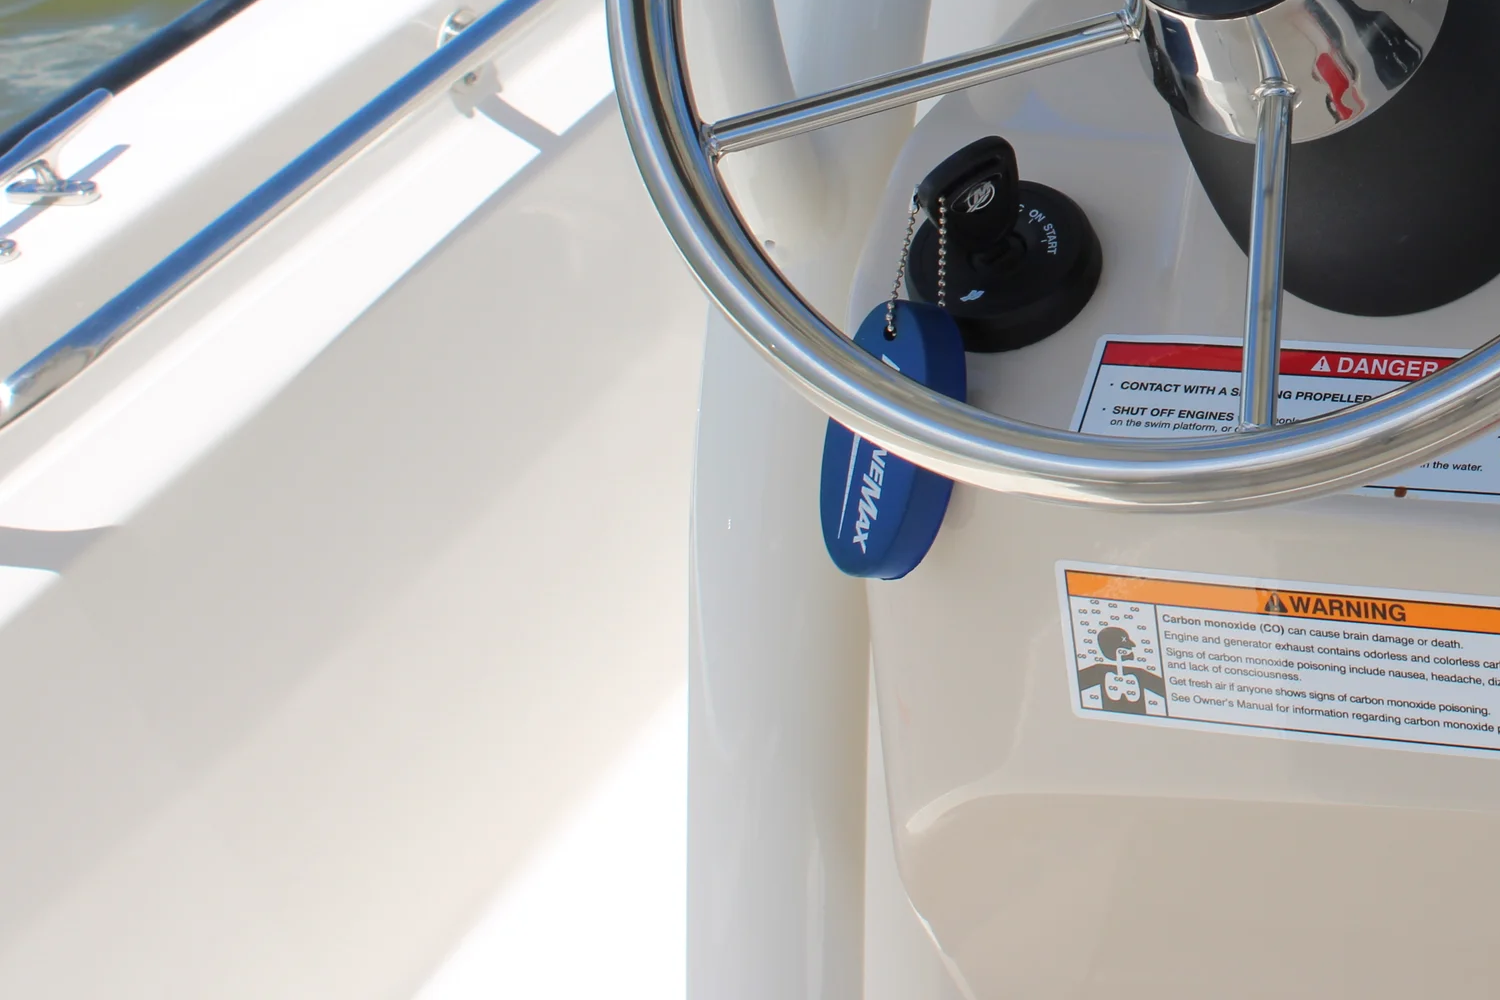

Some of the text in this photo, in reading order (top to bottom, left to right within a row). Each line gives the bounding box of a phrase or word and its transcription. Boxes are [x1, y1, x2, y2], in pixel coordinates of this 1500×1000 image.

[1028, 208, 1058, 255] ON START
[1337, 356, 1439, 378] DANGER
[1120, 380, 1181, 394] CONTACT
[1184, 384, 1216, 395] WITH
[1218, 387, 1228, 396] A
[1110, 418, 1232, 433] on the swim platform, or
[1112, 405, 1234, 422] SHUT OFF ENGINES
[1432, 460, 1449, 470] the
[1452, 462, 1483, 472] water.
[1287, 596, 1407, 622] WARNING
[1162, 614, 1464, 649] Carbon monoxide (CO) can cause brain damage or death.
[1164, 630, 1199, 643] Engine
[1202, 634, 1221, 644] and
[1223, 638, 1272, 649] generator
[1275, 641, 1314, 653] exhaust
[1317, 645, 1360, 657] contains
[1364, 648, 1408, 661] odorless
[1410, 653, 1430, 663] and
[1433, 655, 1480, 667] colorless
[1166, 647, 1193, 660] Signs
[1196, 650, 1206, 660] of
[1208, 652, 1243, 663] carbon
[1245, 656, 1294, 668] monoxide
[1297, 660, 1346, 675] poisoning
[1349, 663, 1385, 676] include
[1388, 669, 1428, 681] nausea,
[1431, 671, 1485, 686] headache,
